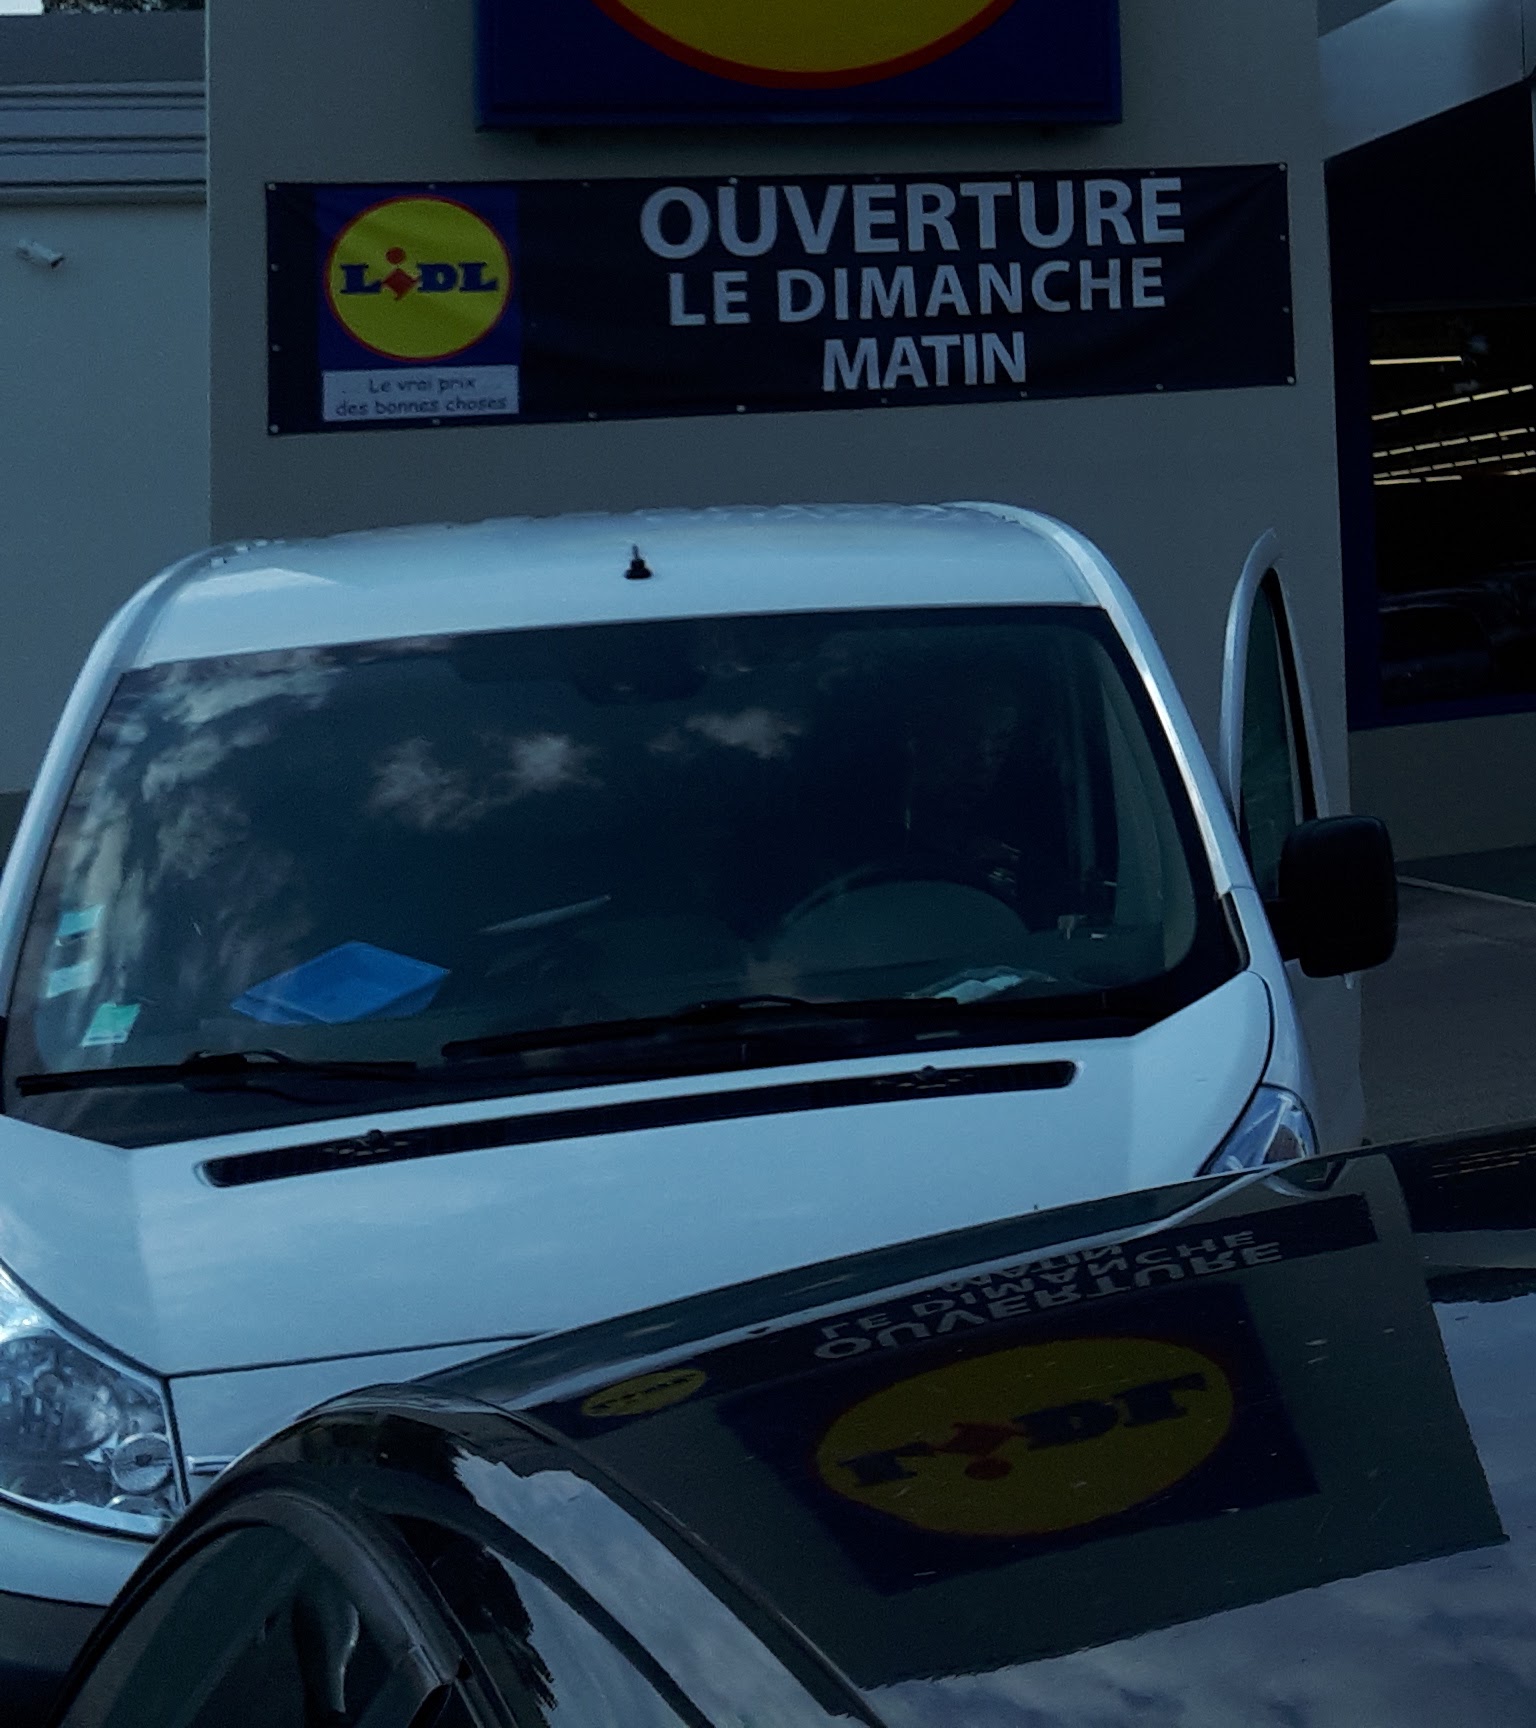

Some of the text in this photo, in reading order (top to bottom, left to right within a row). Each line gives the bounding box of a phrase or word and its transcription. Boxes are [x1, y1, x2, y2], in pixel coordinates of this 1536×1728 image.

[639, 175, 1186, 259] OUVERTURE
[667, 256, 1167, 327] LE DIMANCHE
[369, 376, 477, 394] Le vrai prix
[821, 329, 1028, 393] MATIN
[335, 394, 508, 416] des bonnes choses
